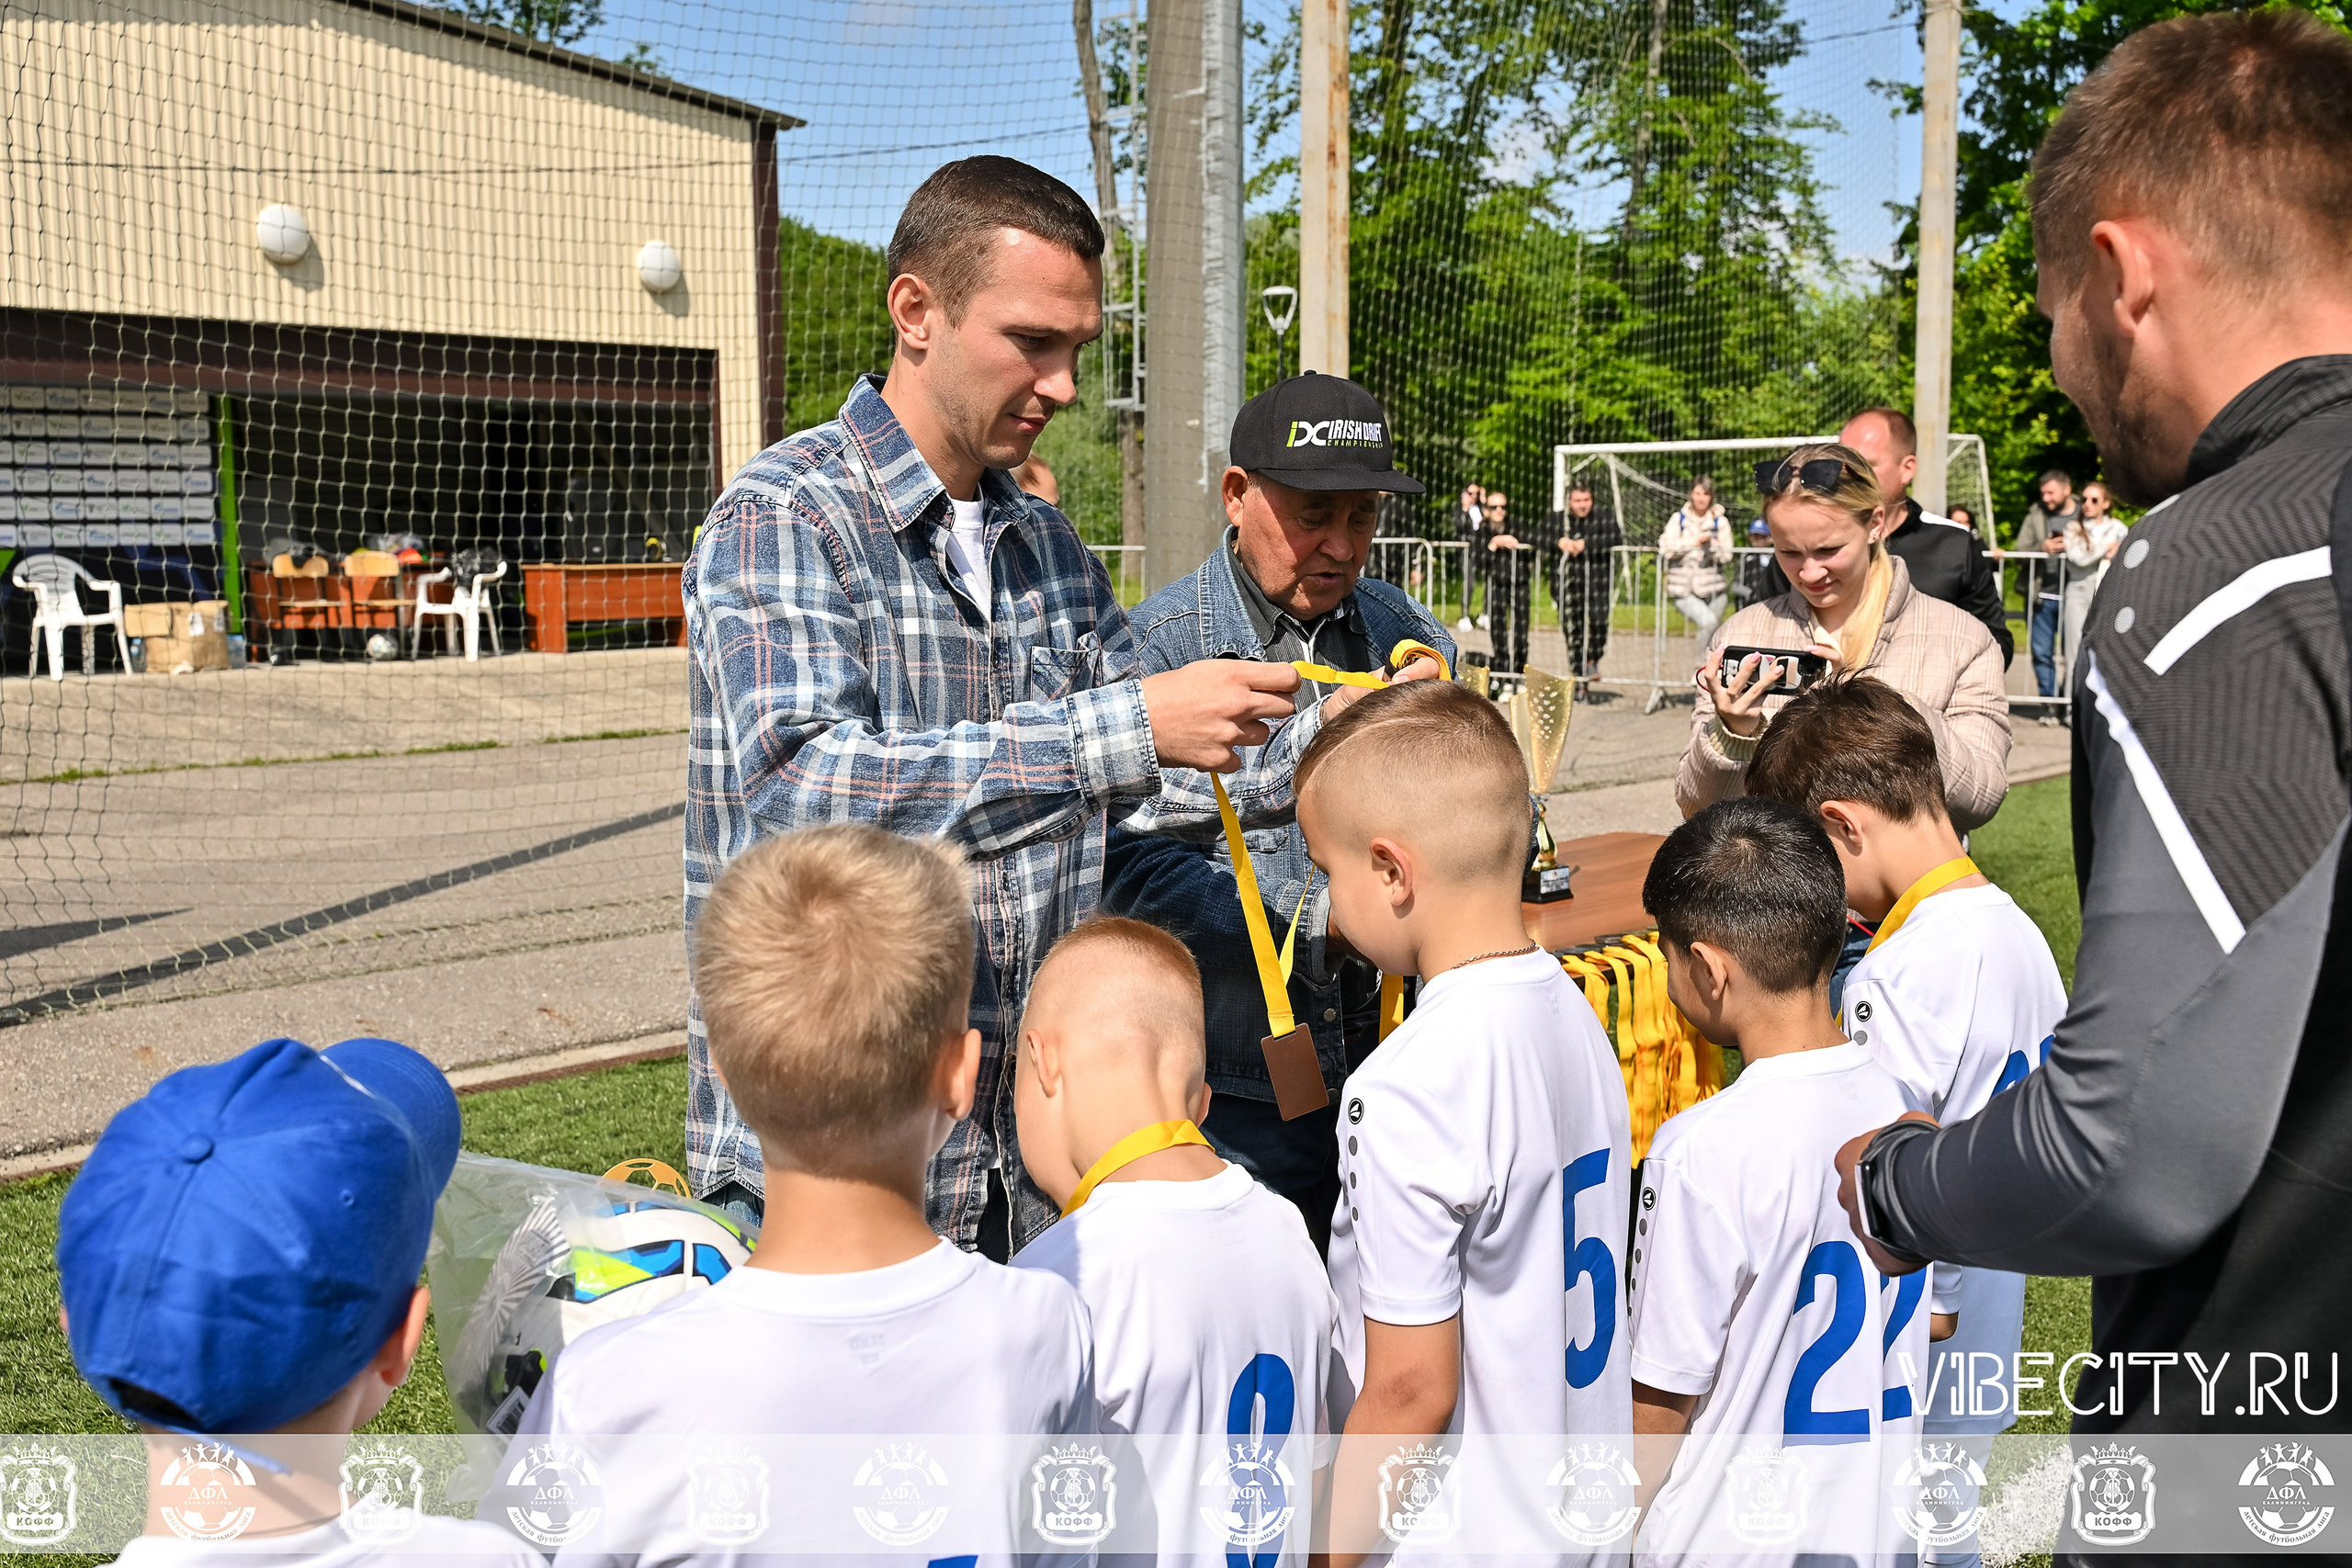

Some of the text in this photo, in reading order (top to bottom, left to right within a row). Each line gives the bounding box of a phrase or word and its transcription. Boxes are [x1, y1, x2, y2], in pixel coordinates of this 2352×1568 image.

[1328, 419, 1363, 440] IRISH
[1563, 1147, 1616, 1389] 5
[1226, 1353, 1295, 1568] 8
